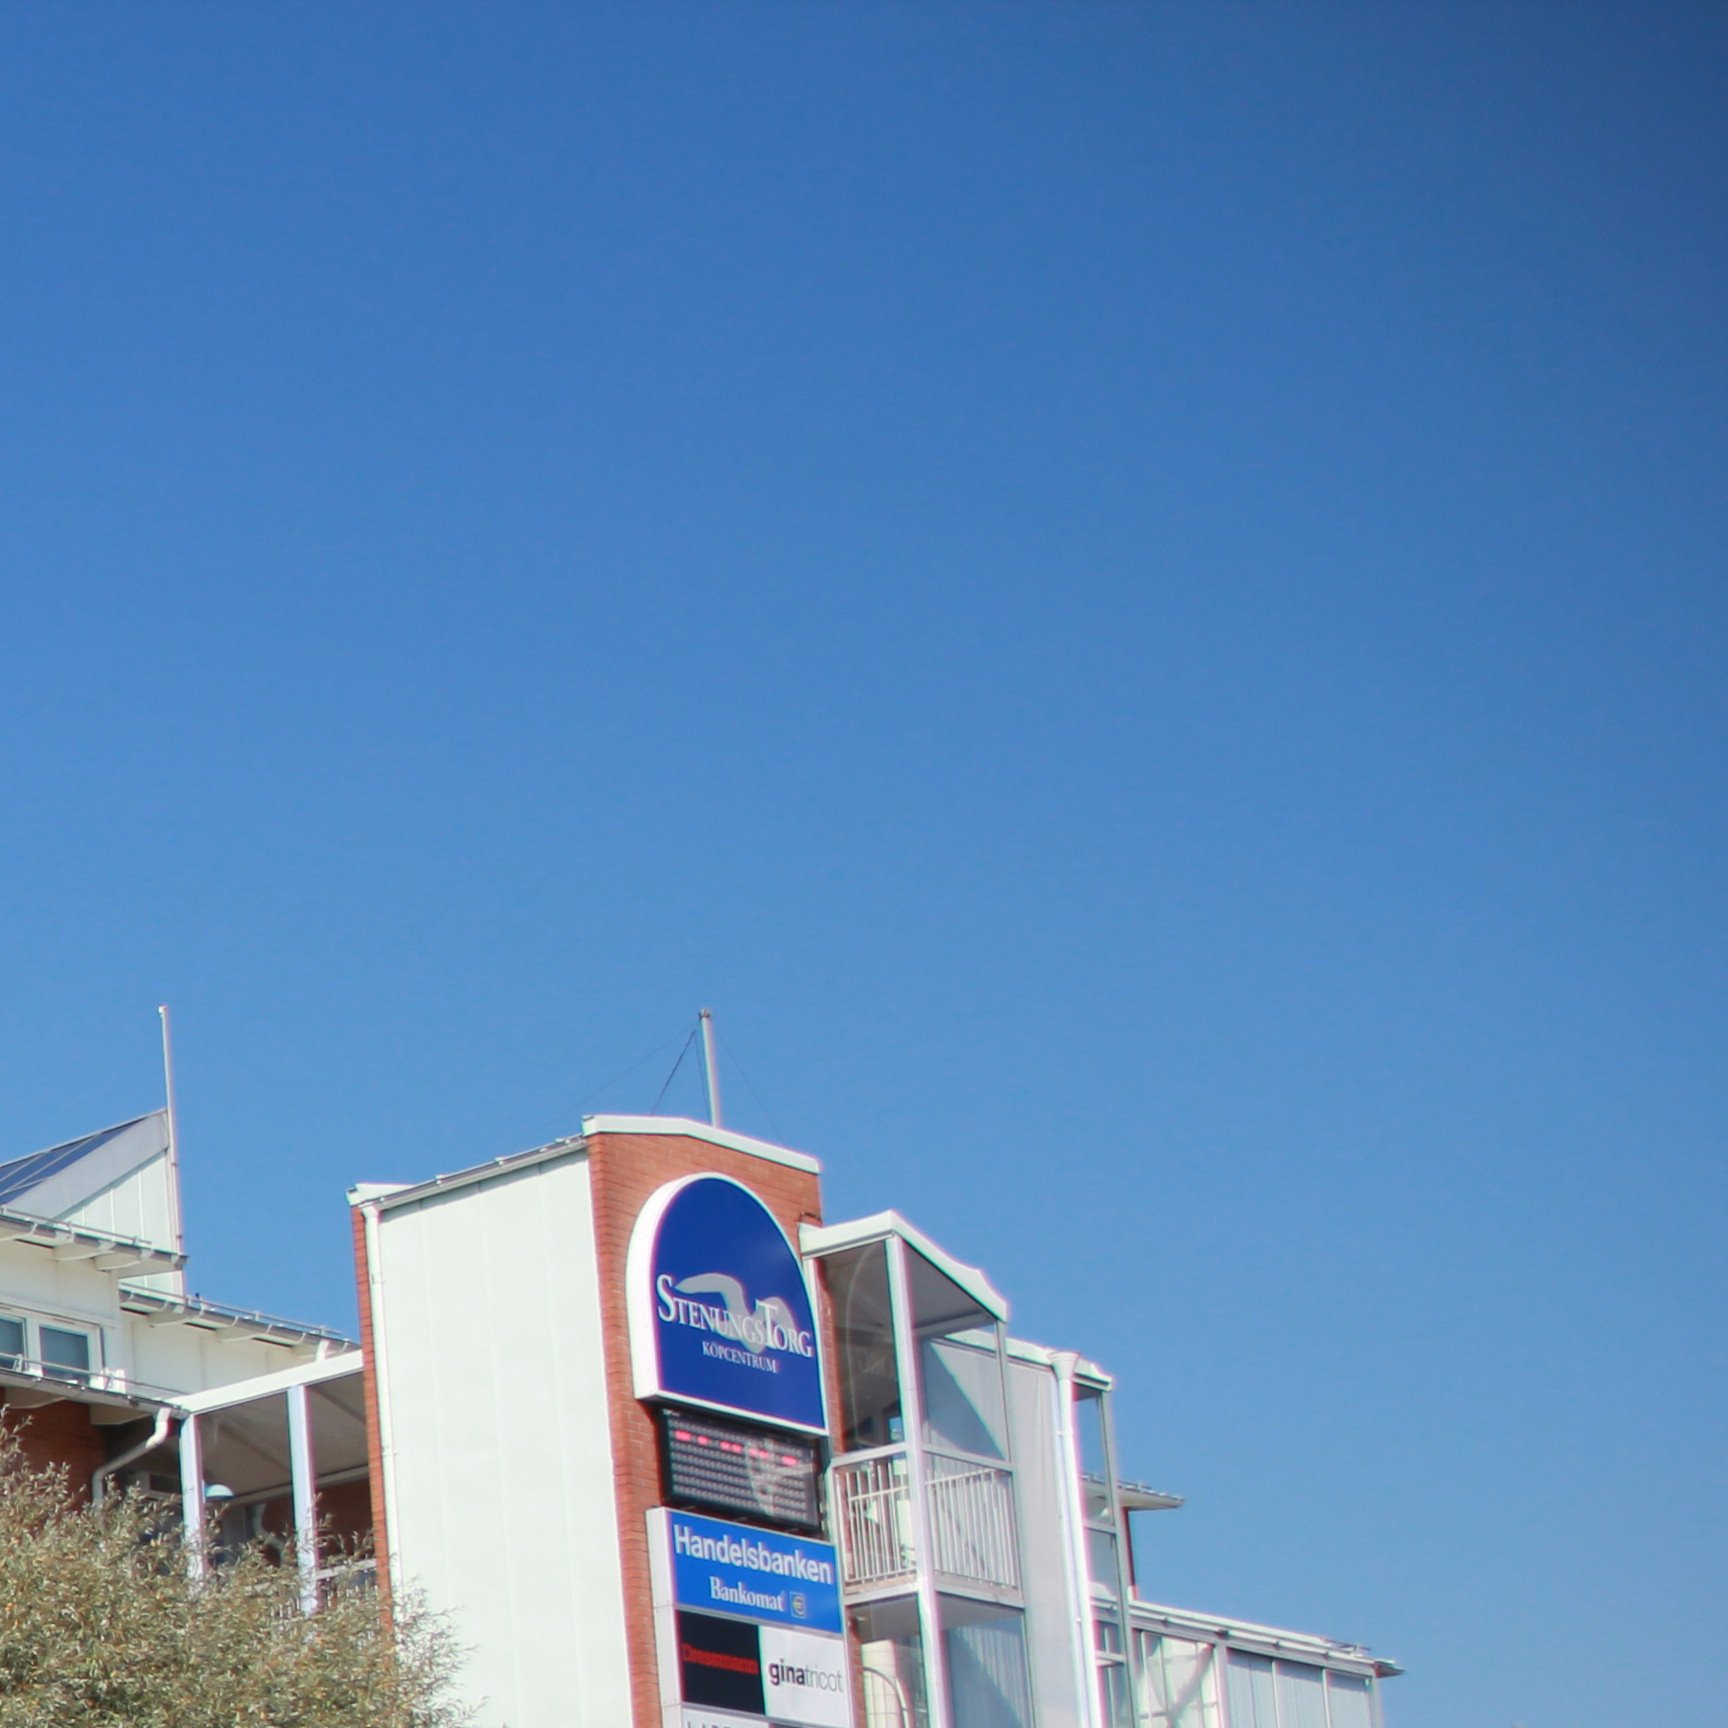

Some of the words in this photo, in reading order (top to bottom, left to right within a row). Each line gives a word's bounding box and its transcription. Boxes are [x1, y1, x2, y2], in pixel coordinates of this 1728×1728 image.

[702, 1341, 778, 1373] KÖPCENTRUM
[674, 1523, 832, 1586] Handelsbanken
[709, 1576, 784, 1612] Bankomat
